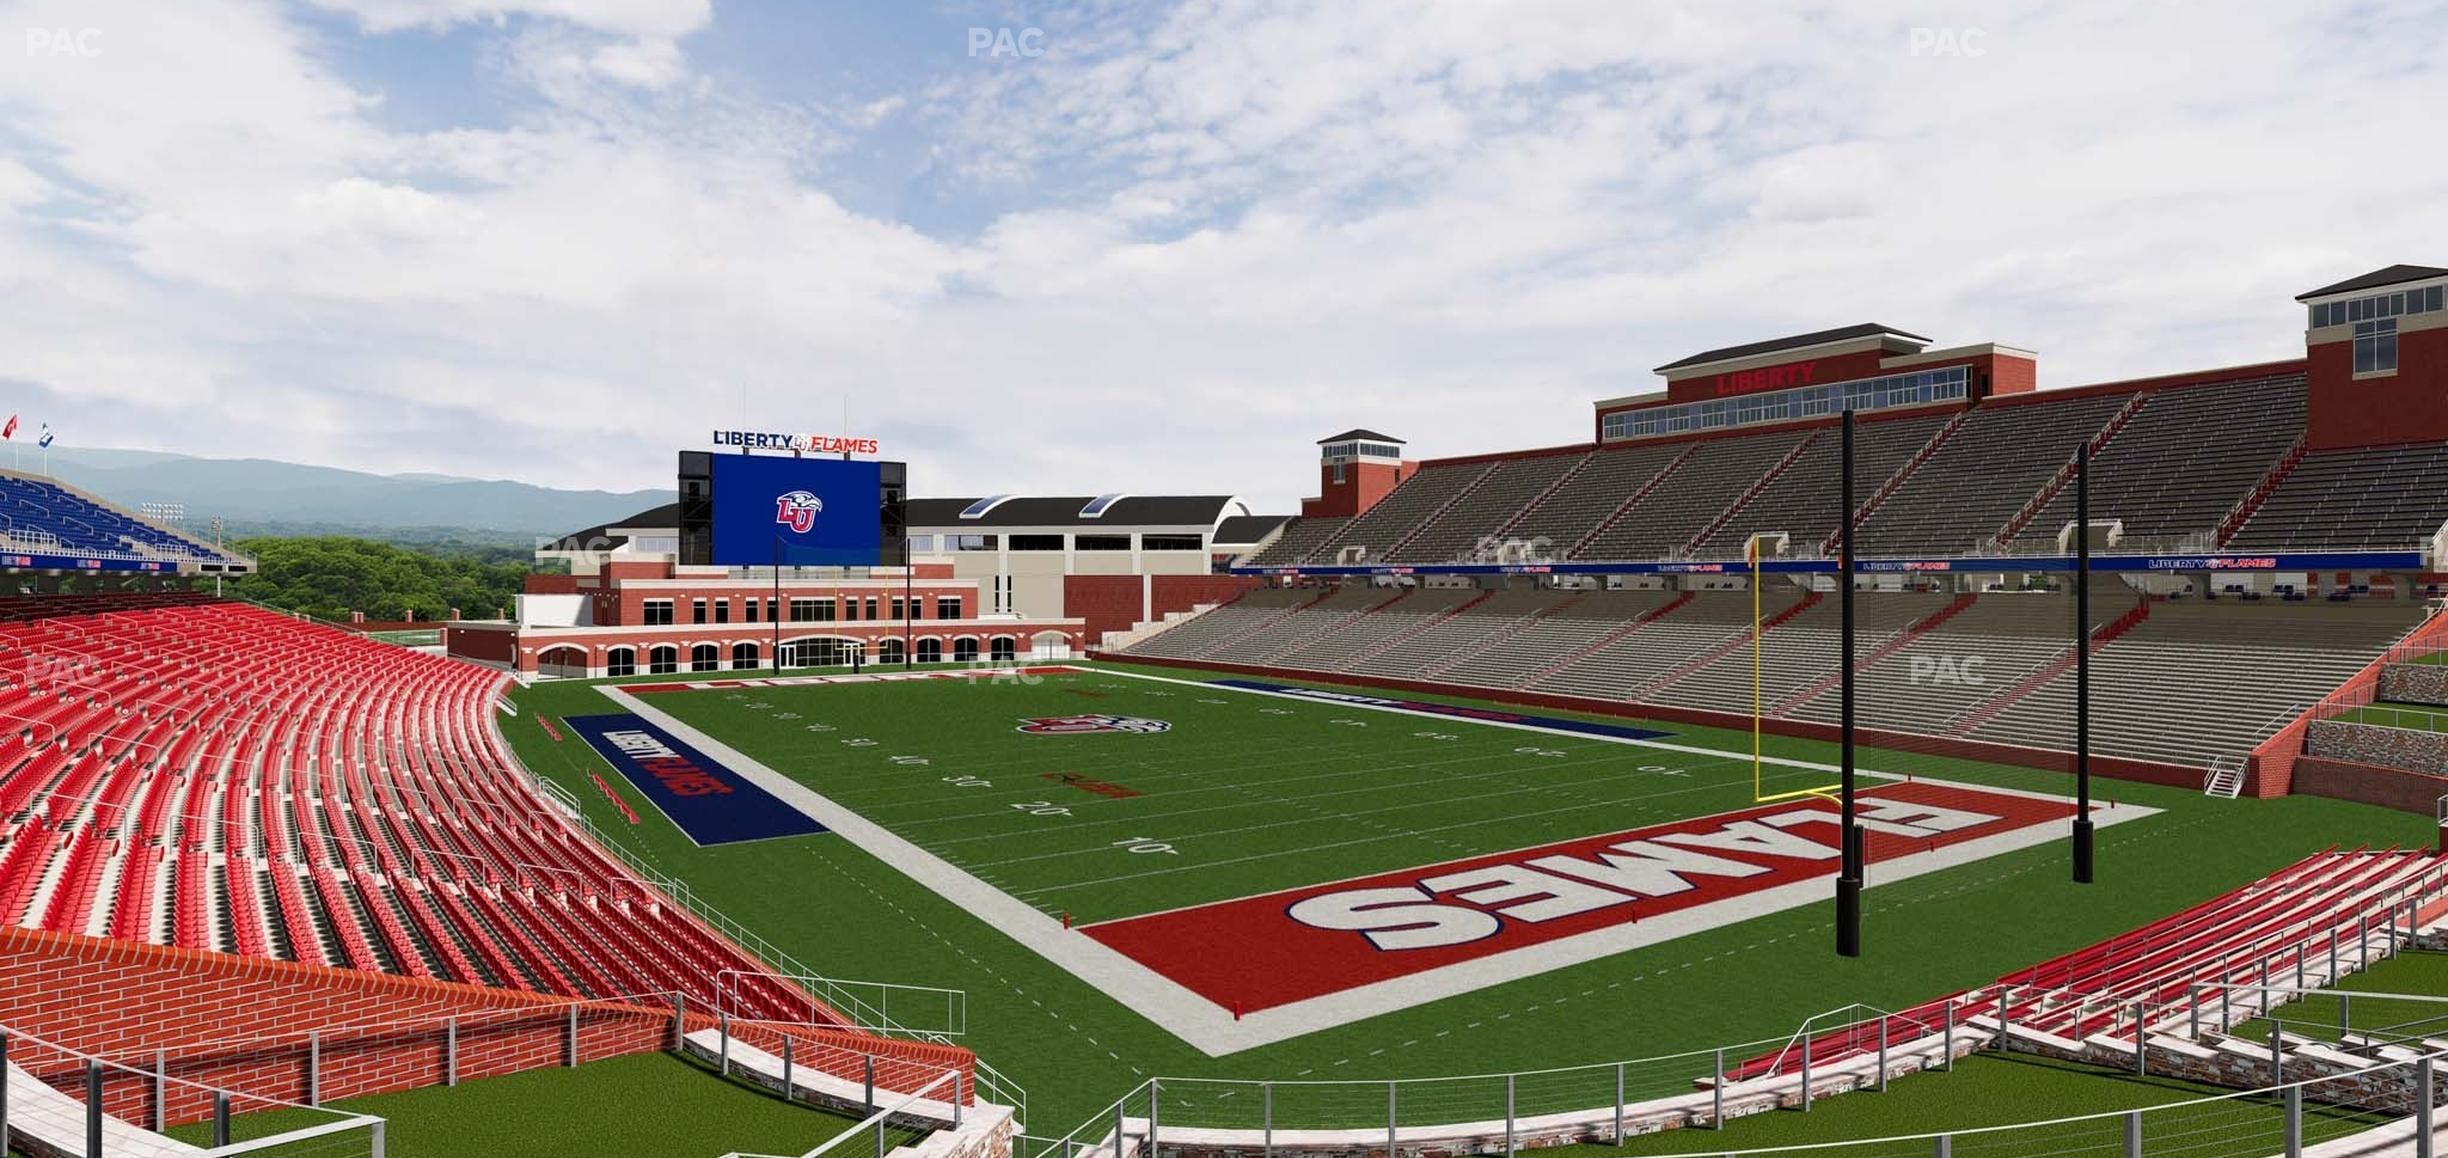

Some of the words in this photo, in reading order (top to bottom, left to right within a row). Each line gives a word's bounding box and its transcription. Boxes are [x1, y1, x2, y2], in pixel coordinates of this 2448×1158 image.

[1715, 362, 1817, 395] LIBERTY
[713, 430, 793, 448] LIBERTY
[811, 436, 878, 454] FLAMES
[777, 498, 816, 533] LU
[2149, 559, 2209, 569] LIBERTY
[1010, 800, 1073, 817] 20
[1112, 836, 1179, 855] 10
[1284, 795, 2006, 953] FLAMES
